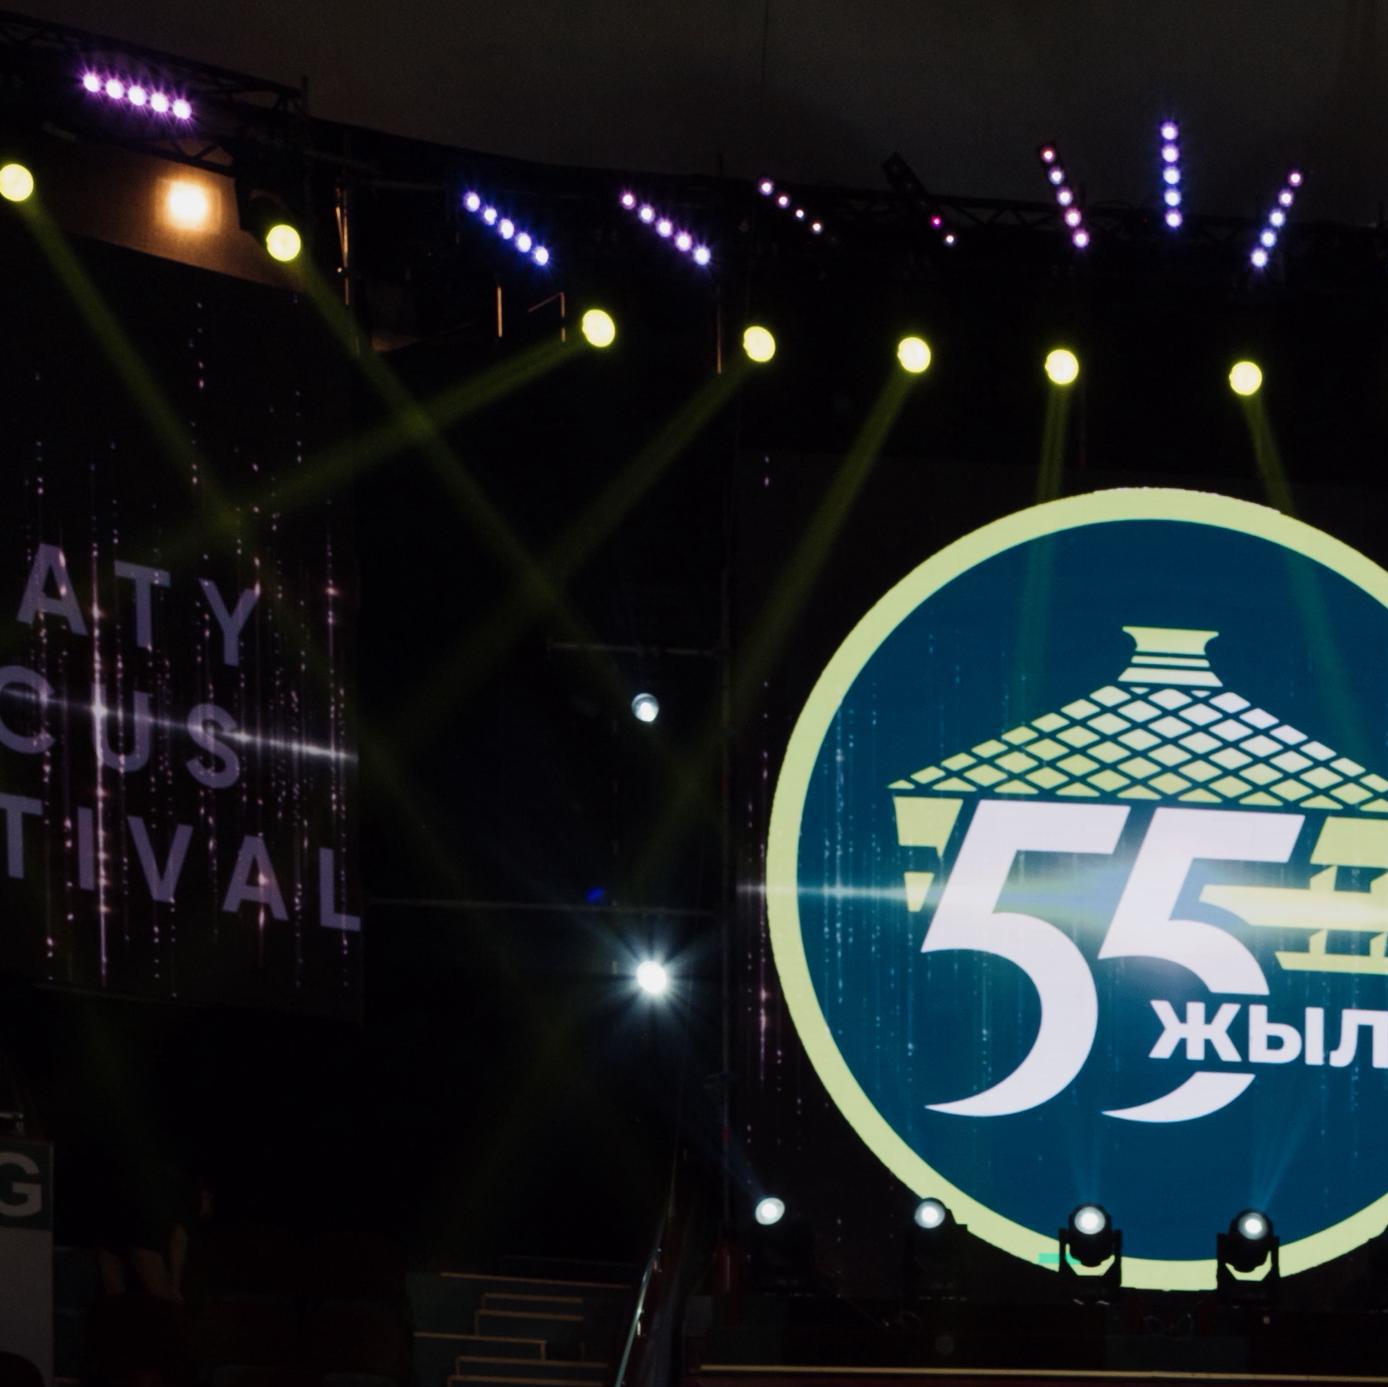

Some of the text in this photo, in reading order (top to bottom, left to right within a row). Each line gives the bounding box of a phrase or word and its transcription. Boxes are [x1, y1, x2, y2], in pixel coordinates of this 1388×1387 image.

[16, 542, 260, 668] ATY
[0, 664, 240, 789] CUS
[0, 792, 363, 932] TIVAL
[921, 799, 1305, 1122] 55
